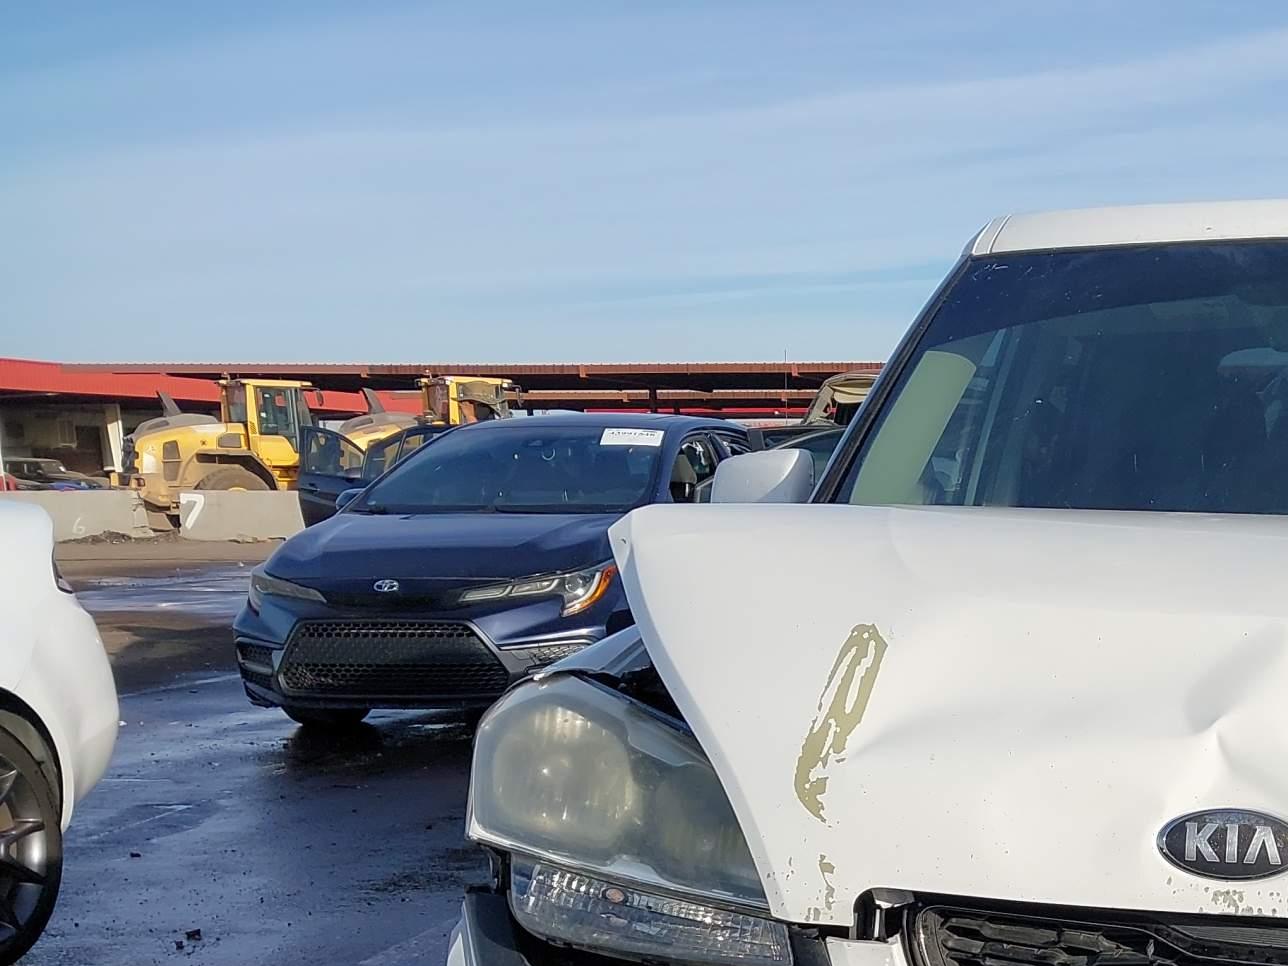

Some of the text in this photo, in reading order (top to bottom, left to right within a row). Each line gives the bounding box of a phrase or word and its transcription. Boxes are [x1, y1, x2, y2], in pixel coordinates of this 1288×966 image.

[72, 516, 86, 534] 6
[179, 493, 204, 530] 7
[1184, 821, 1281, 865] KIA
